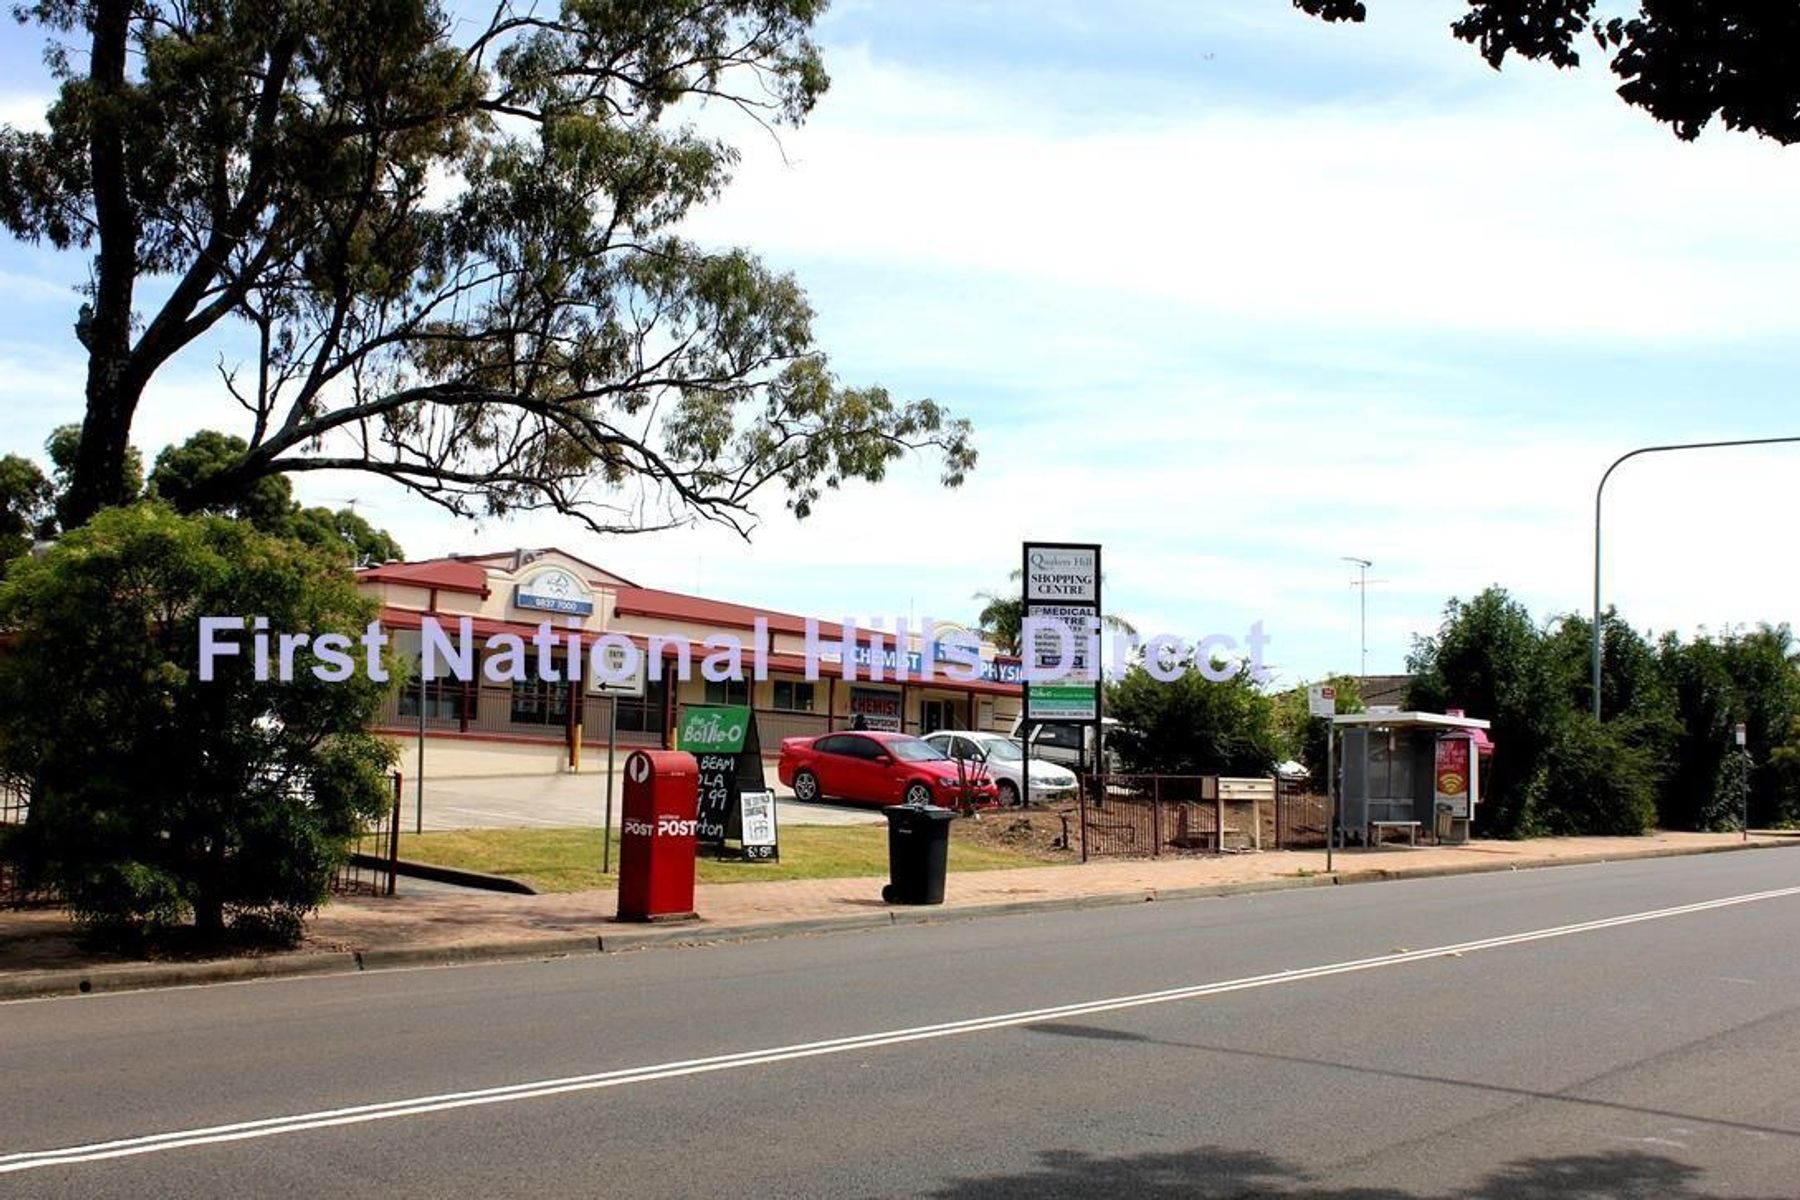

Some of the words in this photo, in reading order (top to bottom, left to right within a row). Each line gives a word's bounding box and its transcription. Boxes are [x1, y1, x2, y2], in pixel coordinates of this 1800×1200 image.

[1031, 574, 1092, 584] SHOPPING
[1038, 585, 1086, 595] CENTRE
[1043, 607, 1094, 617] MEDICAL
[850, 646, 920, 670] CHEMIST
[980, 661, 1023, 682] PHYSI
[700, 755, 735, 771] BEAM
[624, 821, 654, 837] POST
[657, 820, 698, 837] POST
